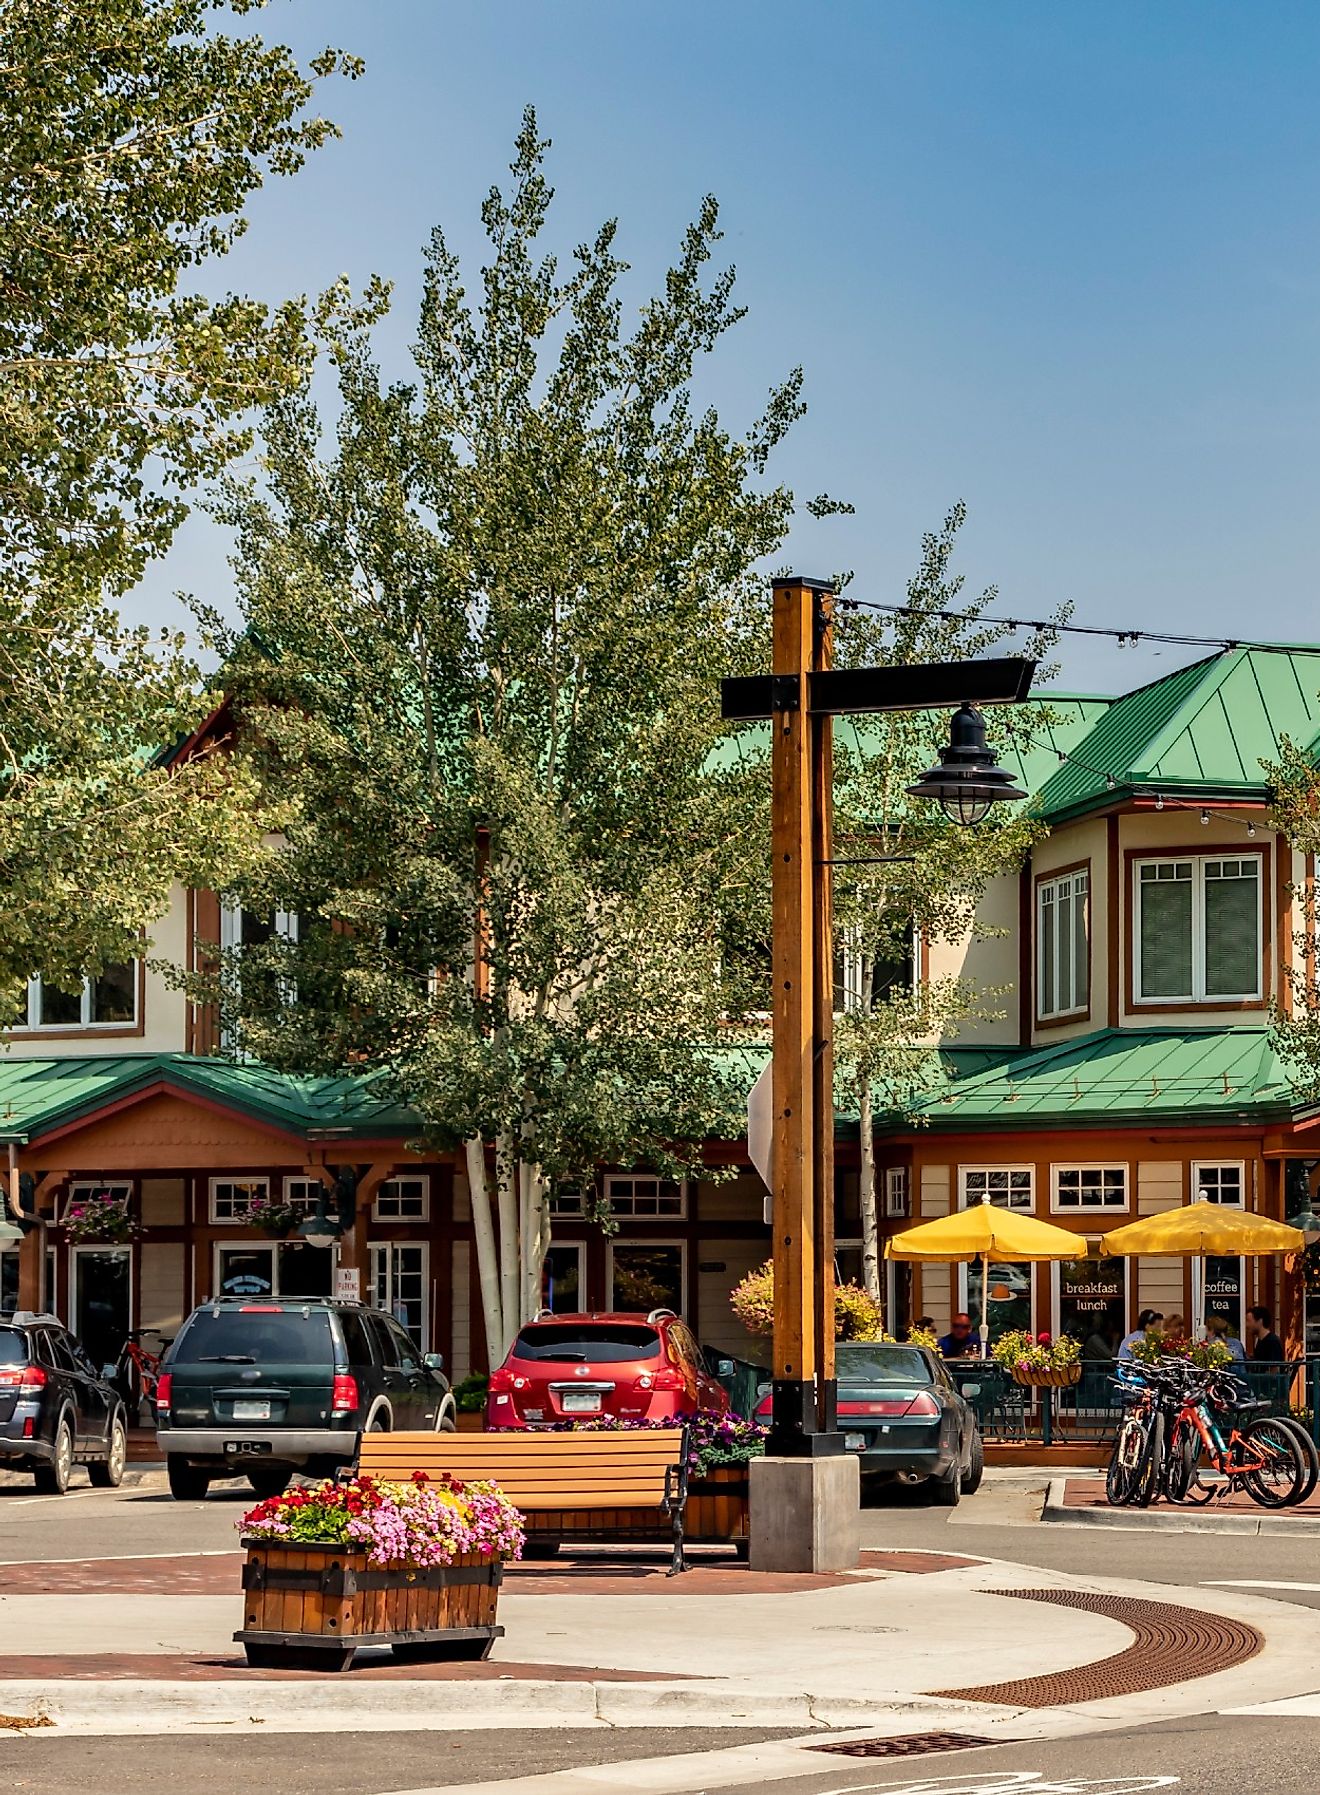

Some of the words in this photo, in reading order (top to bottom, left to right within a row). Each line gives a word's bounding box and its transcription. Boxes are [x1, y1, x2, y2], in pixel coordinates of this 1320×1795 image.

[1066, 1282, 1118, 1294] breakfast
[1204, 1280, 1238, 1293] coffee
[1076, 1299, 1107, 1311] lunch
[1212, 1299, 1230, 1310] tea
